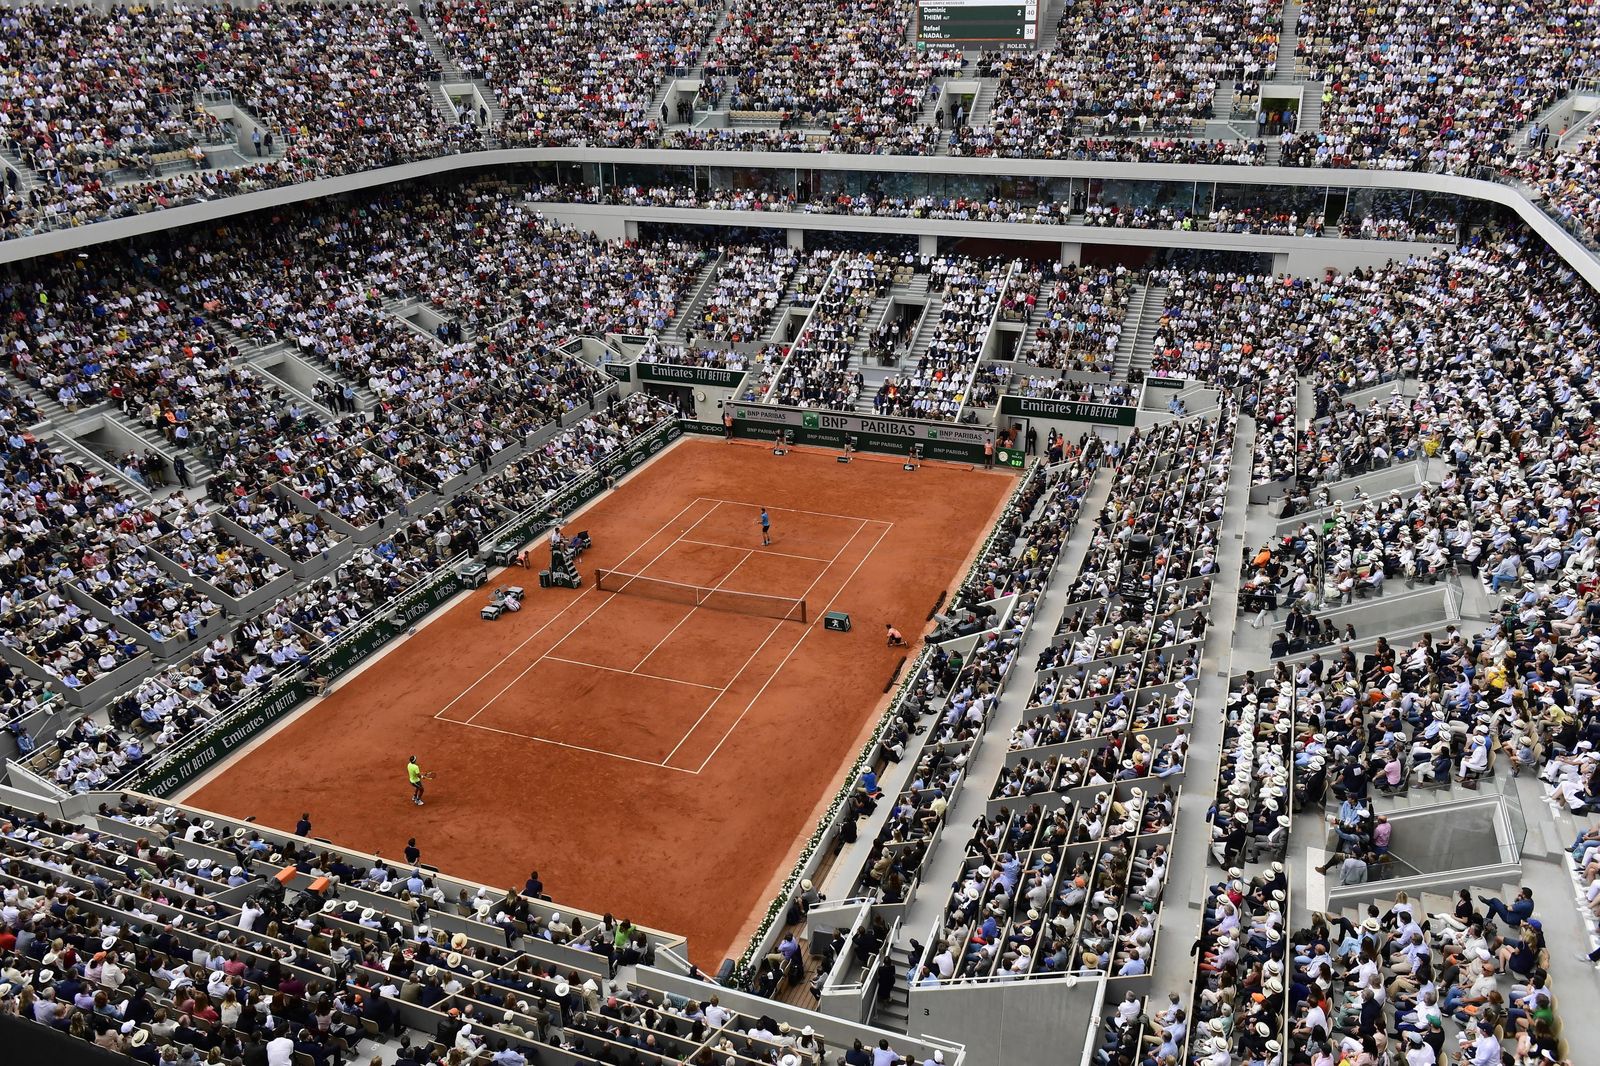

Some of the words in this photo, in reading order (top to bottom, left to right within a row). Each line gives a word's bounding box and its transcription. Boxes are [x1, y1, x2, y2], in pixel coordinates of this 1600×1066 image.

[651, 365, 694, 379] Emirates
[696, 369, 707, 380] FLY
[708, 371, 731, 382] BETTER
[761, 411, 786, 420] PARIBAS
[1020, 399, 1072, 414] Emirates
[1075, 405, 1089, 416] FLY
[1089, 406, 1118, 419] BETTER
[822, 416, 848, 429] BNP
[861, 420, 916, 437] PARIBAS
[939, 429, 953, 437] BNP
[955, 431, 983, 441] PARIBAS
[946, 449, 969, 457] PARIBAS
[580, 480, 600, 498] oppo
[558, 496, 578, 514] oppo
[433, 581, 457, 601] Infosys
[405, 600, 429, 621] Infosys
[371, 633, 391, 649] ROLEX
[347, 649, 368, 665] ROLEX
[327, 665, 344, 680] OLEX
[221, 714, 265, 749] Emirates
[265, 704, 277, 720] FLY
[275, 690, 298, 713] BETTER
[147, 774, 179, 798] irates
[179, 763, 192, 779] FLY
[192, 746, 217, 771] BETTER
[923, 1008, 930, 1016] 3
